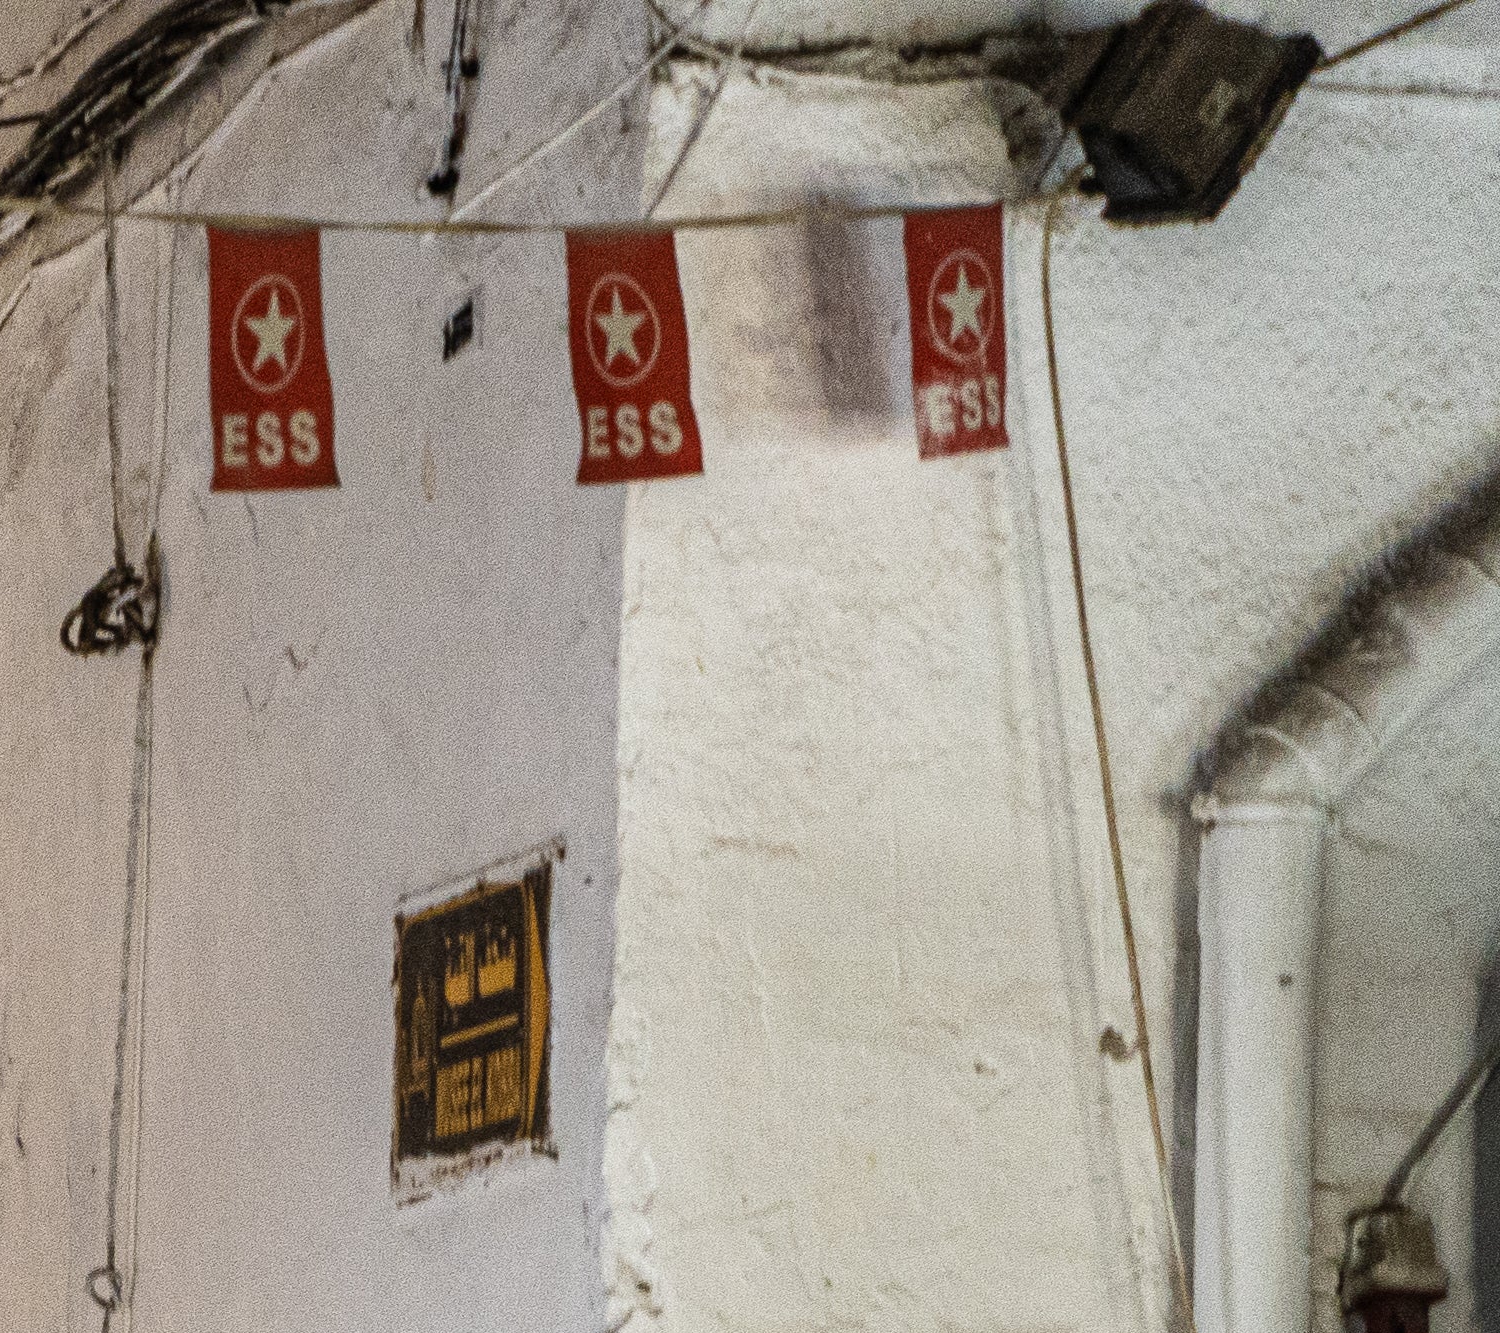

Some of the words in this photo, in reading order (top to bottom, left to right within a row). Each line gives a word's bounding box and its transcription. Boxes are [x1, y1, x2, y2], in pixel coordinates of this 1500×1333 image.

[588, 401, 683, 459] ESS
[924, 373, 1003, 435] ESS
[222, 411, 320, 468] ESS
